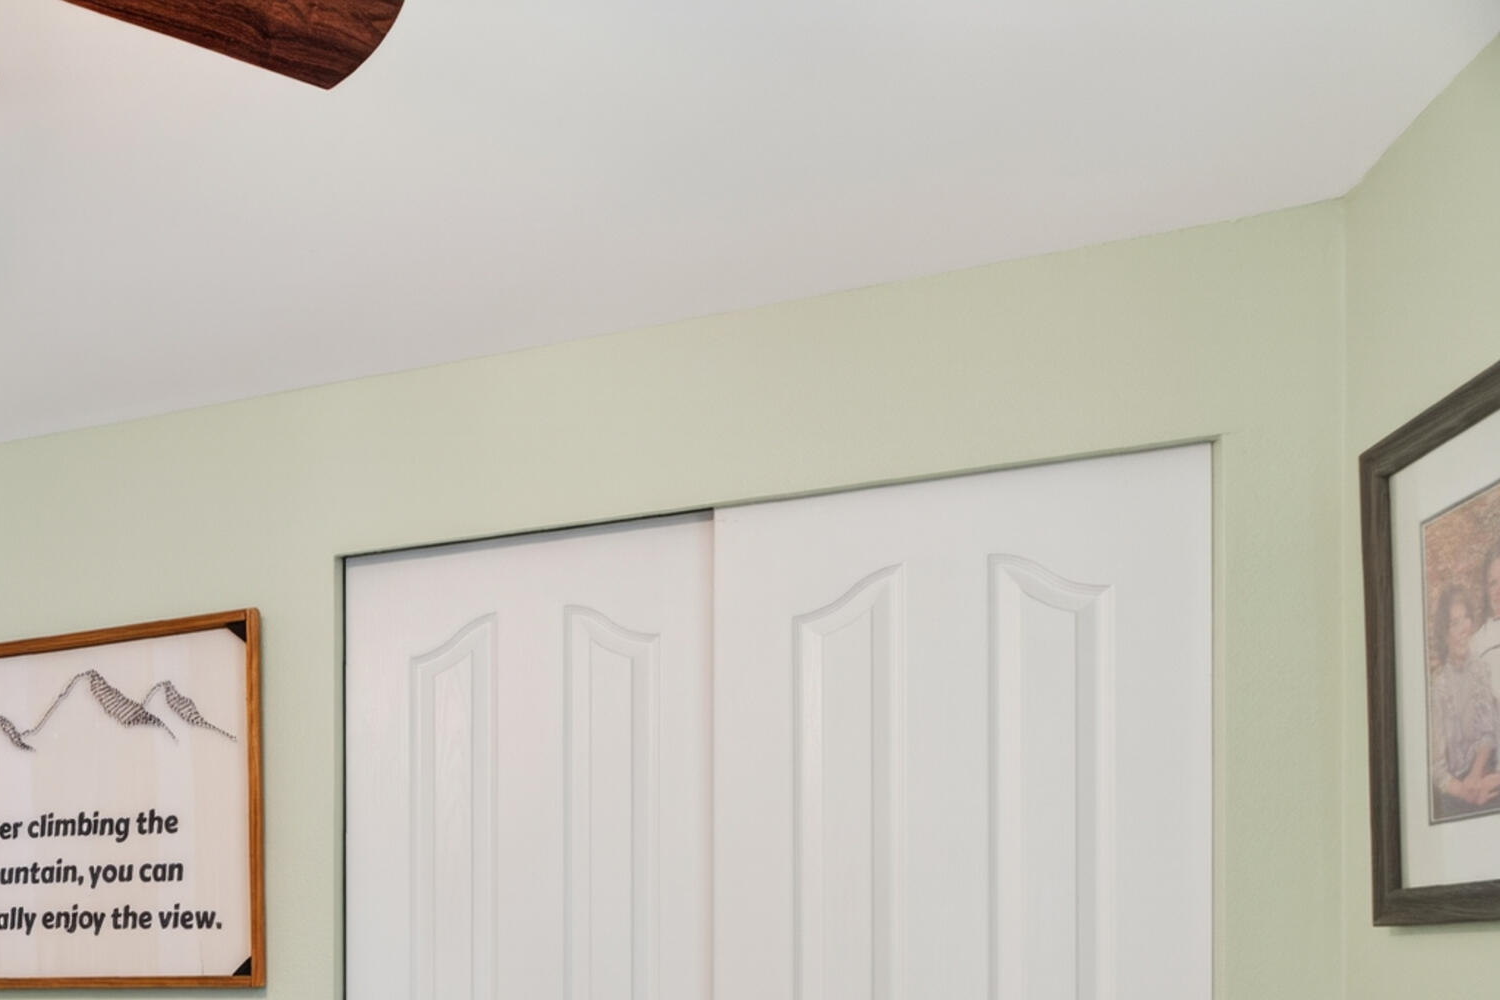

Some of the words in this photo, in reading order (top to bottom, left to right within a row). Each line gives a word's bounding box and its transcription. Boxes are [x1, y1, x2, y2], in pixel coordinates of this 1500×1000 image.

[27, 811, 131, 843] climbing
[135, 808, 179, 836] the
[88, 864, 134, 889] you
[138, 862, 184, 883] can
[41, 903, 106, 936] enjoy
[110, 904, 153, 930] the
[158, 903, 222, 930] view.
